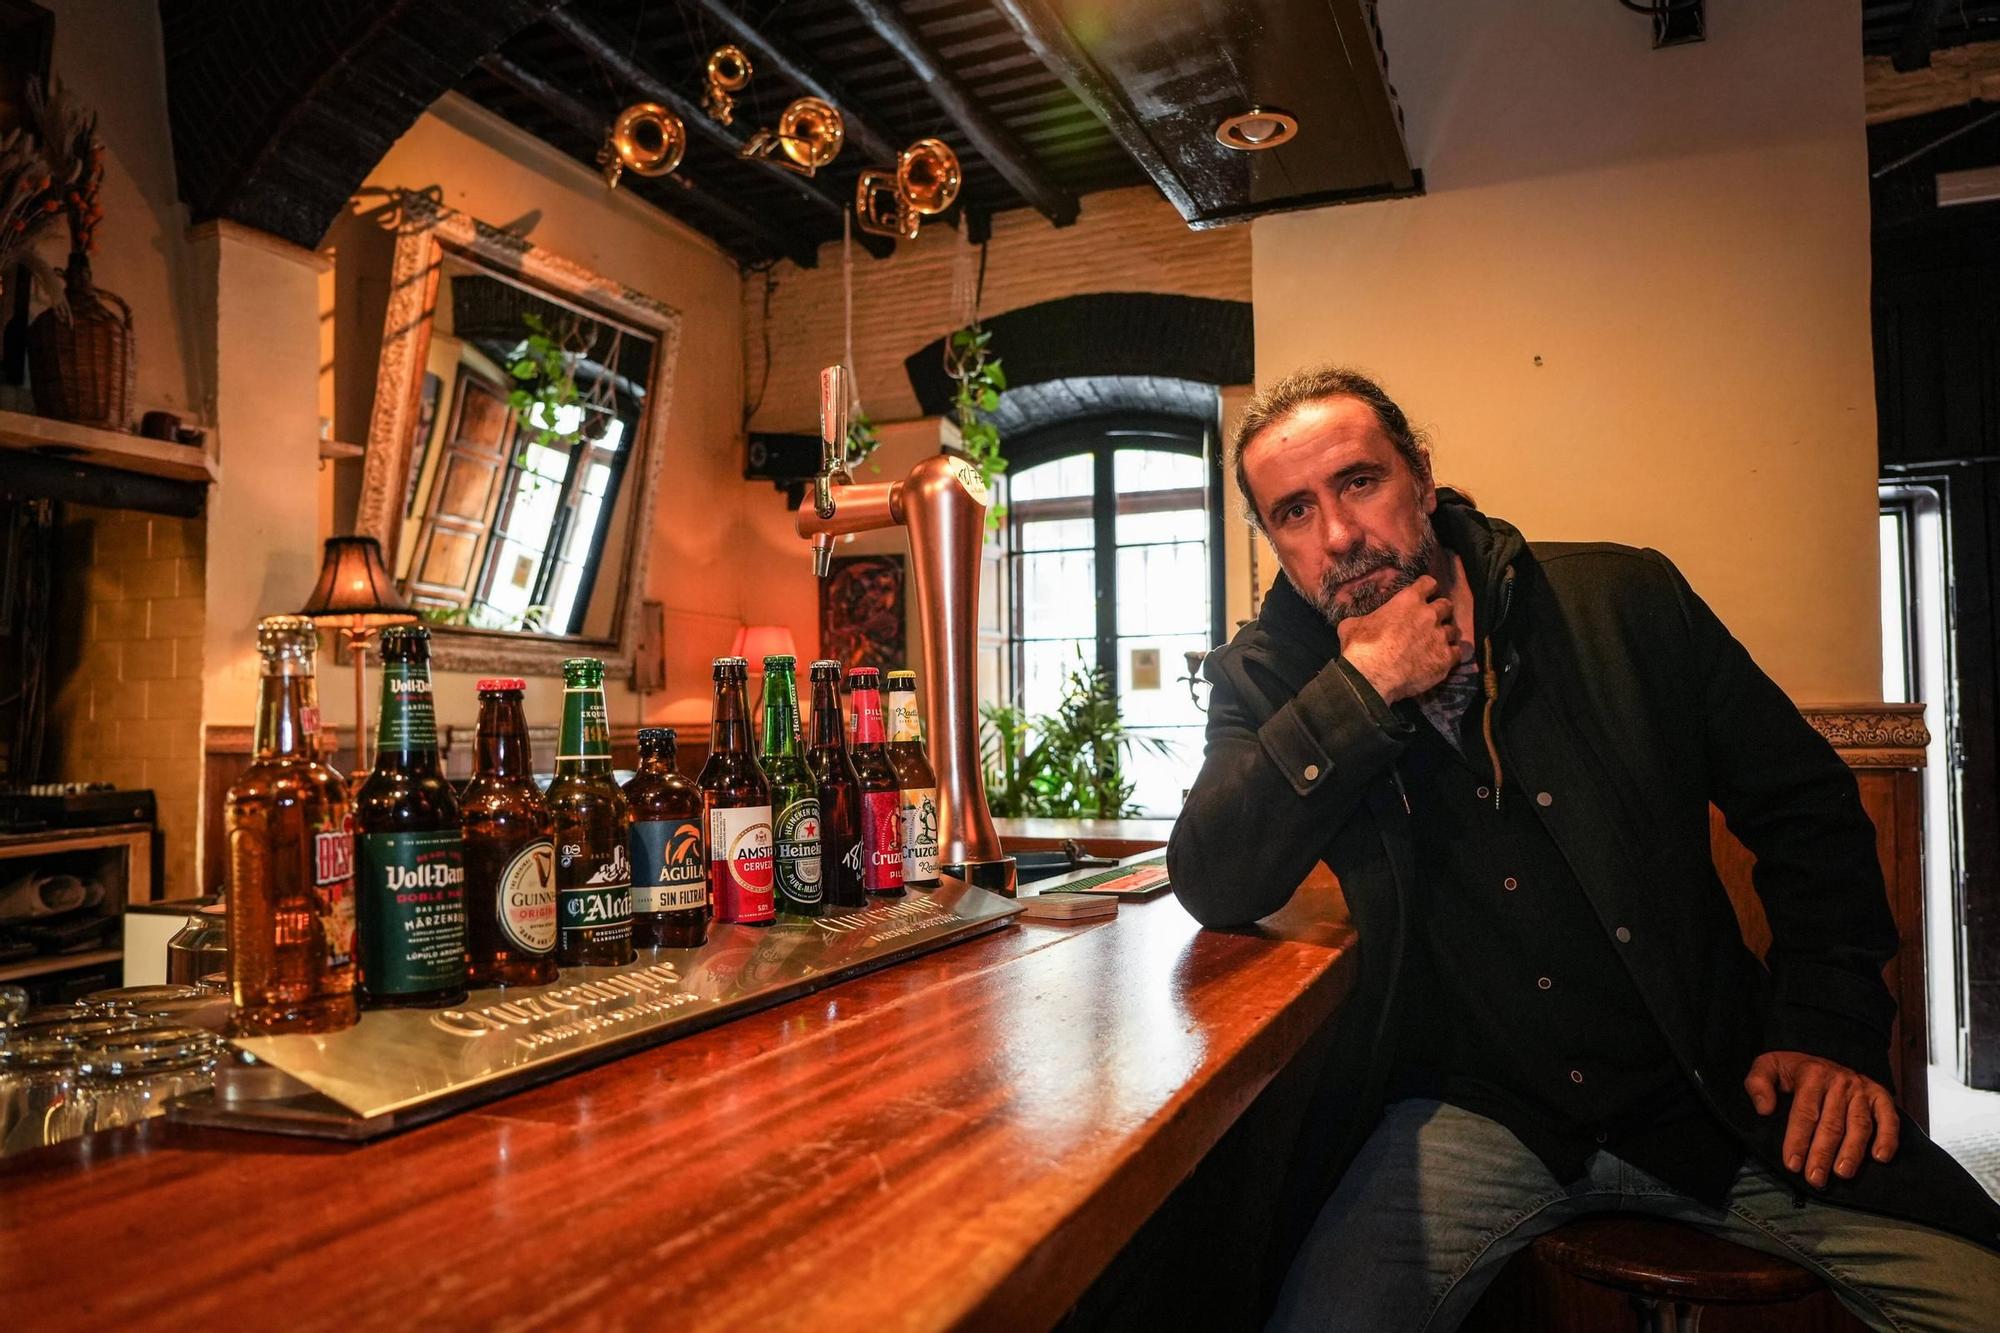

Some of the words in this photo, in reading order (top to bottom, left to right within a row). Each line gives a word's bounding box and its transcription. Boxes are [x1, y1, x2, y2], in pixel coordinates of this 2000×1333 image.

[790, 683, 800, 732] Heineken
[784, 807, 811, 836] HEINEKEN
[686, 857, 693, 866] EL
[658, 865, 705, 882] ÁGUILA
[660, 891, 677, 907] SIN
